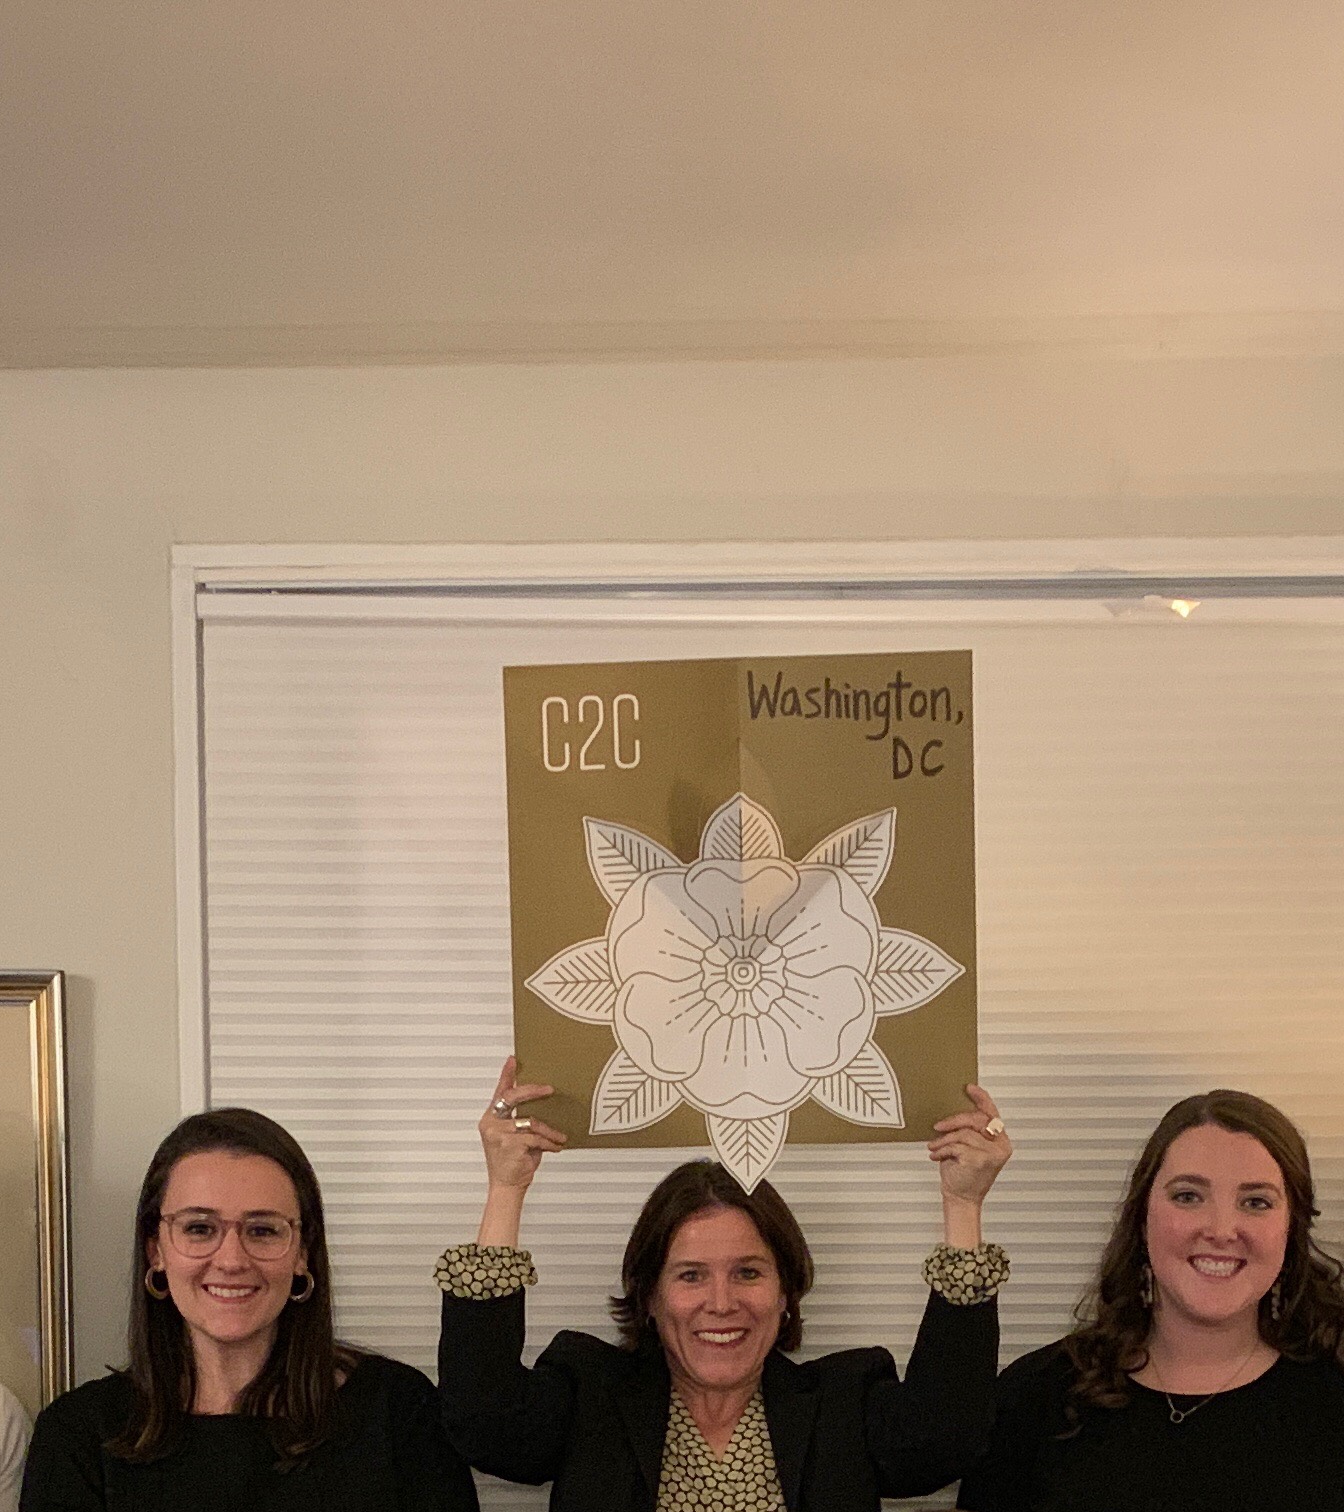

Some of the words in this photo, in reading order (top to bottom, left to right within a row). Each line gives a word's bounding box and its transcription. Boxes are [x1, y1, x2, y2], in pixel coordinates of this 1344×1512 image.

[541, 693, 642, 773] C2C
[747, 670, 964, 741] Washington,
[892, 738, 945, 780] DC
